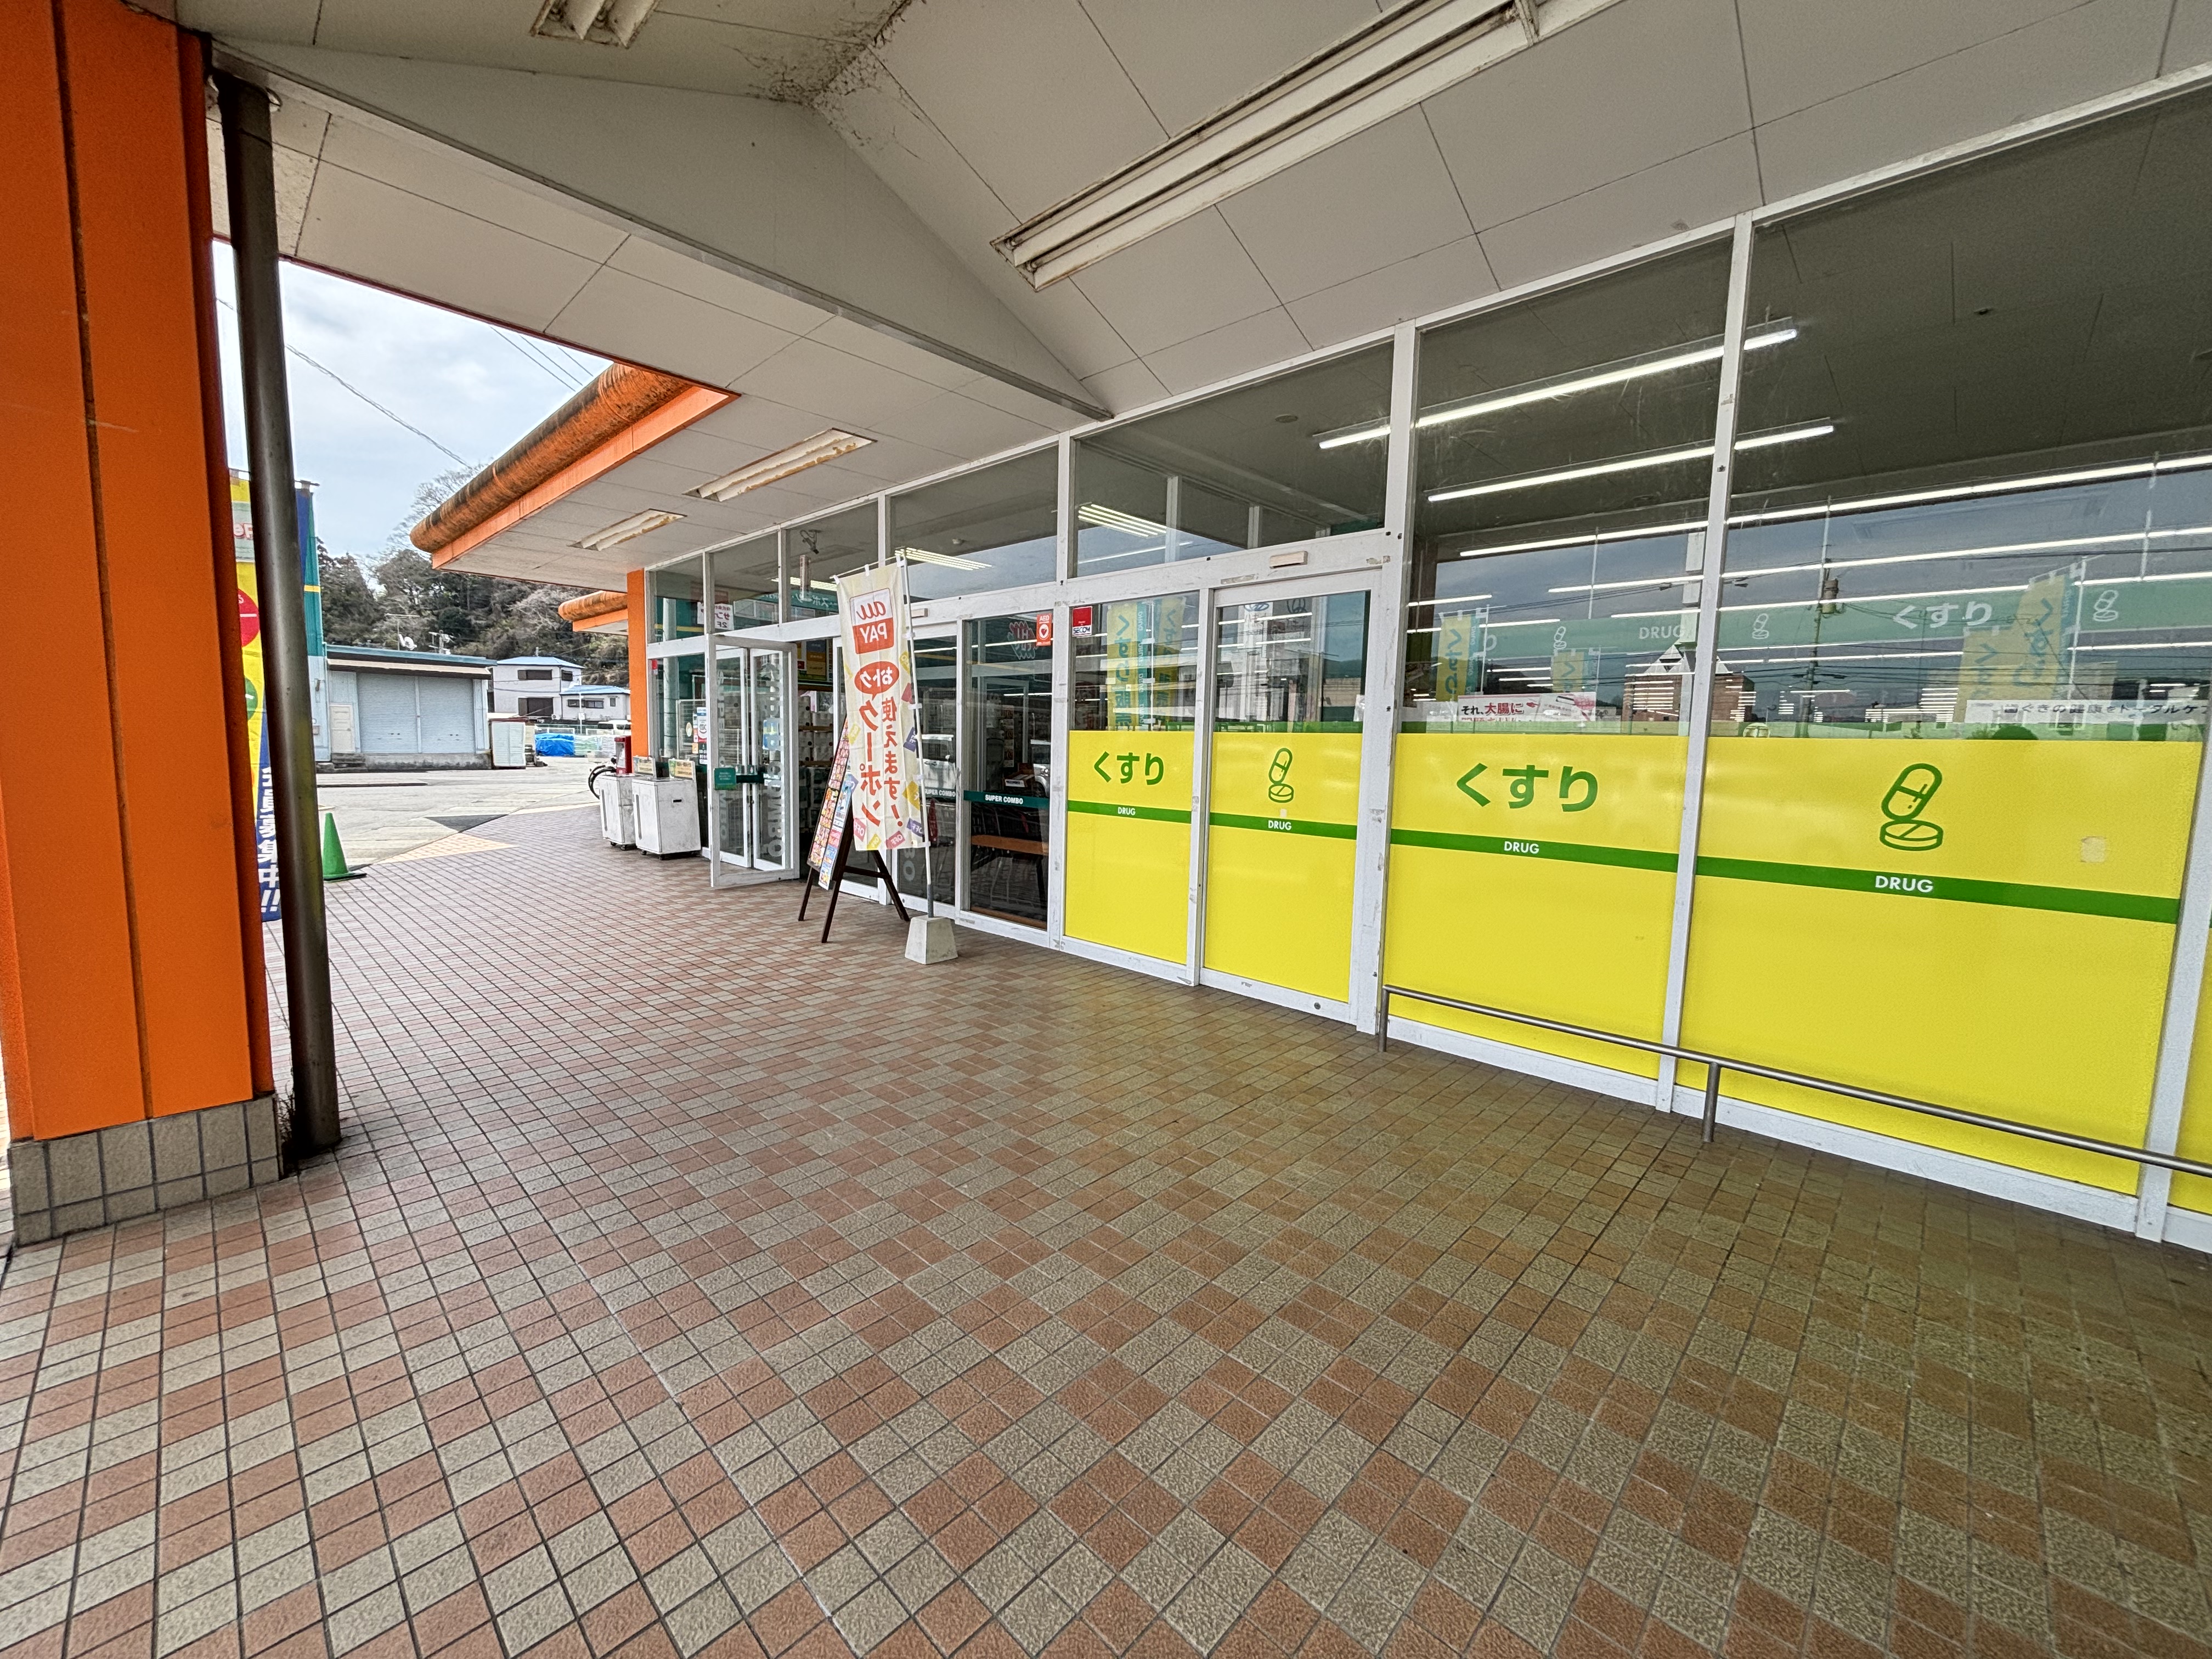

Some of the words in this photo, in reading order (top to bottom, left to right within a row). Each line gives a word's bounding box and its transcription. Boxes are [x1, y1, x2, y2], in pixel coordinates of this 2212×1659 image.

[1893, 601, 1993, 629] くすり
[1461, 702, 1524, 716] それ、大腸に
[1093, 752, 1164, 785] くすり
[1457, 763, 1598, 812] くすり
[985, 794, 1002, 803] SUPER
[1003, 796, 1024, 805] COMBO
[1118, 806, 1136, 816] DRUG
[1268, 820, 1292, 831] DRUG
[1504, 840, 1540, 854] DRUG
[1875, 875, 1934, 893] DRUG
